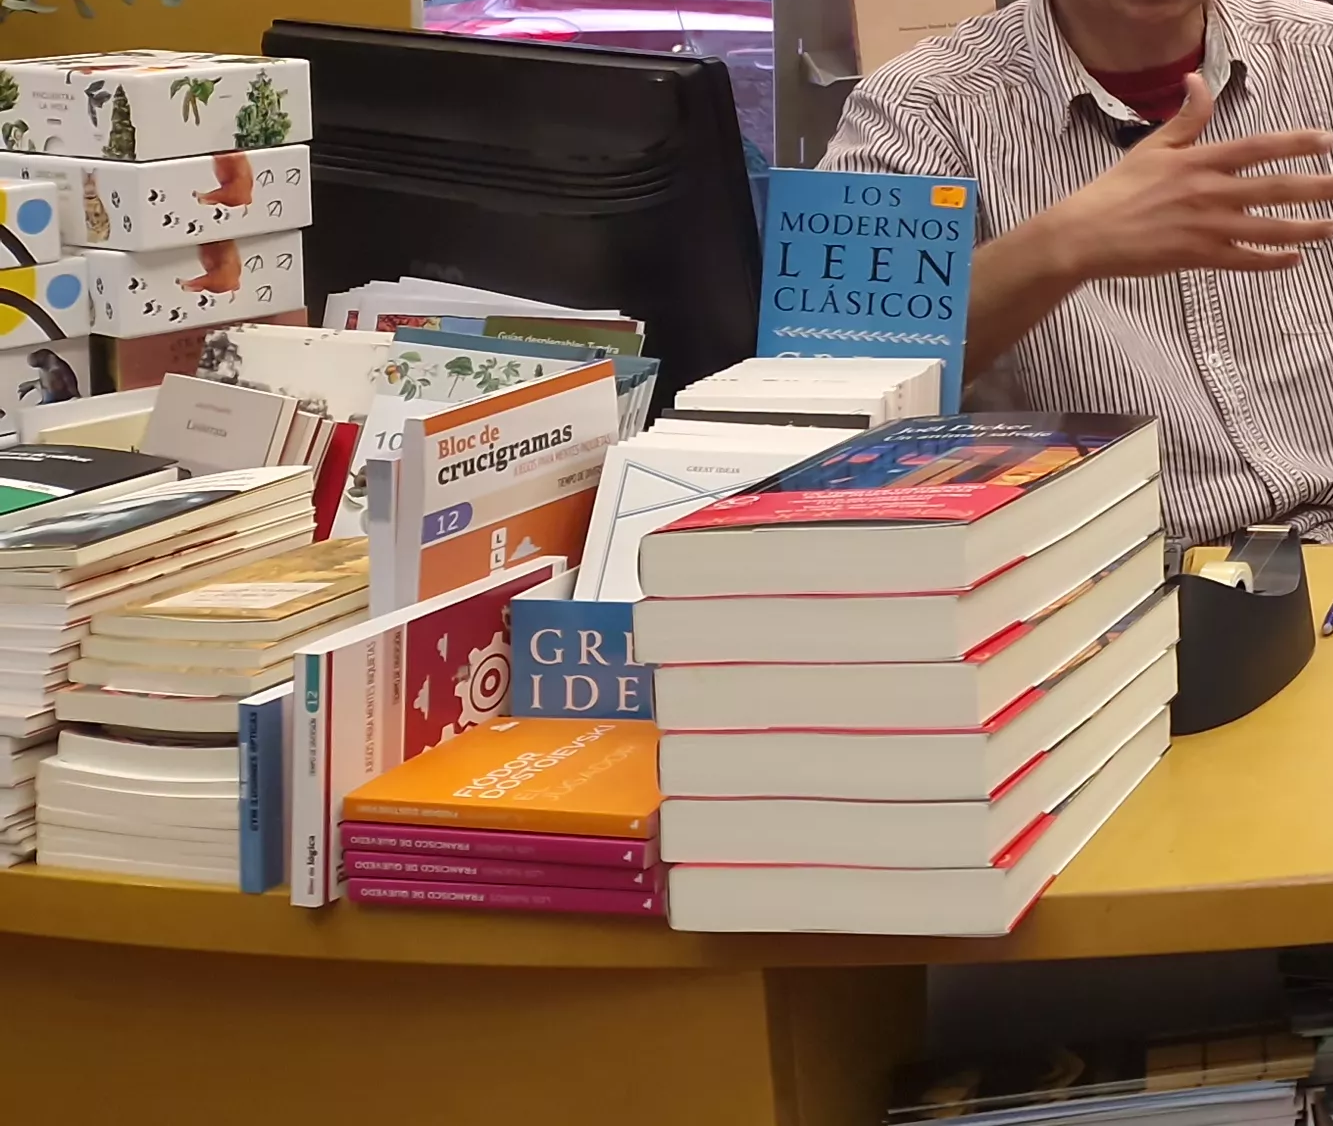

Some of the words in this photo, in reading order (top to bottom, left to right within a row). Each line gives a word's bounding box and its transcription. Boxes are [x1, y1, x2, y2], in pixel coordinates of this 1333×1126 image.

[843, 185, 902, 208] LOS
[779, 212, 960, 241] MODERNOS
[778, 241, 956, 287] LEEN
[773, 285, 954, 320] CLÁSICOS
[949, 423, 1032, 433] Dicker
[437, 434, 476, 459] Bloc
[479, 424, 500, 444] de
[438, 424, 573, 485] crucigramas
[686, 465, 717, 474] GREAT
[436, 510, 459, 536] 12
[307, 690, 318, 706] 12
[478, 725, 616, 799] DOSTOIEVSKI
[453, 752, 542, 798] FIÓDOR
[350, 836, 396, 846] QUEVEDO
[400, 838, 414, 847] DE
[415, 839, 469, 851] FRANCISCO
[355, 860, 402, 871] QUEVEDO
[405, 863, 418, 872] DE
[421, 864, 477, 875] FRANCISCO
[361, 887, 408, 898] QUEVEDO
[412, 890, 425, 899] DE
[427, 891, 484, 902] FRANCISCO
